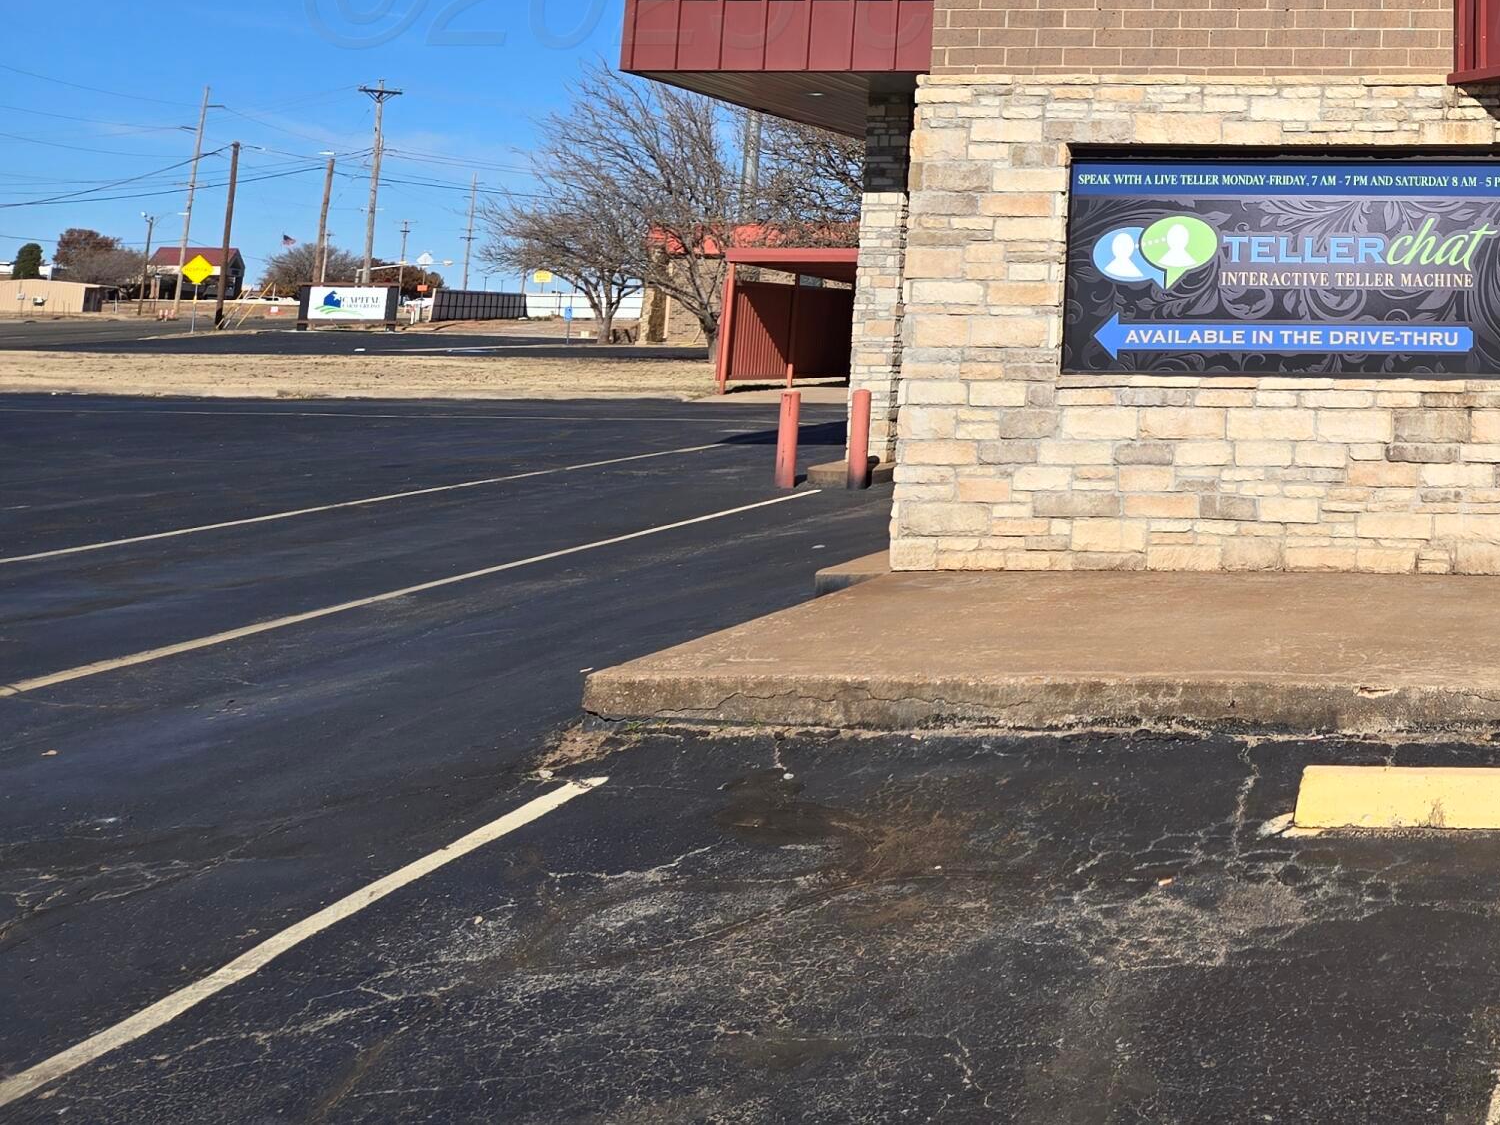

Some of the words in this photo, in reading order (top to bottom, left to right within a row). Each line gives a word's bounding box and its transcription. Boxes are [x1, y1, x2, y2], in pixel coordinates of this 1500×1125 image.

[1078, 173, 1110, 185] SPEAK
[1114, 174, 1142, 185] WITH
[1144, 174, 1152, 185] A
[1154, 174, 1178, 185] LIVE
[1180, 174, 1219, 185] TELLER
[1311, 176, 1318, 186] 7
[1320, 176, 1337, 186] AM
[1344, 176, 1351, 186] 7
[1353, 176, 1368, 186] PM
[1370, 176, 1393, 186] AND
[1395, 176, 1450, 186] SATURDAY
[1451, 176, 1458, 187] 8
[1460, 176, 1477, 187] AM
[1485, 177, 1492, 187] 5
[1221, 271, 1329, 287] INTERACTIVE
[1335, 272, 1395, 287] TELLER
[1400, 272, 1474, 288] MACHINE
[1125, 330, 1245, 345] AVAILABLE
[1252, 330, 1274, 345] IN
[1280, 331, 1321, 346] THE
[1329, 331, 1459, 346] DRIVE-THRU
